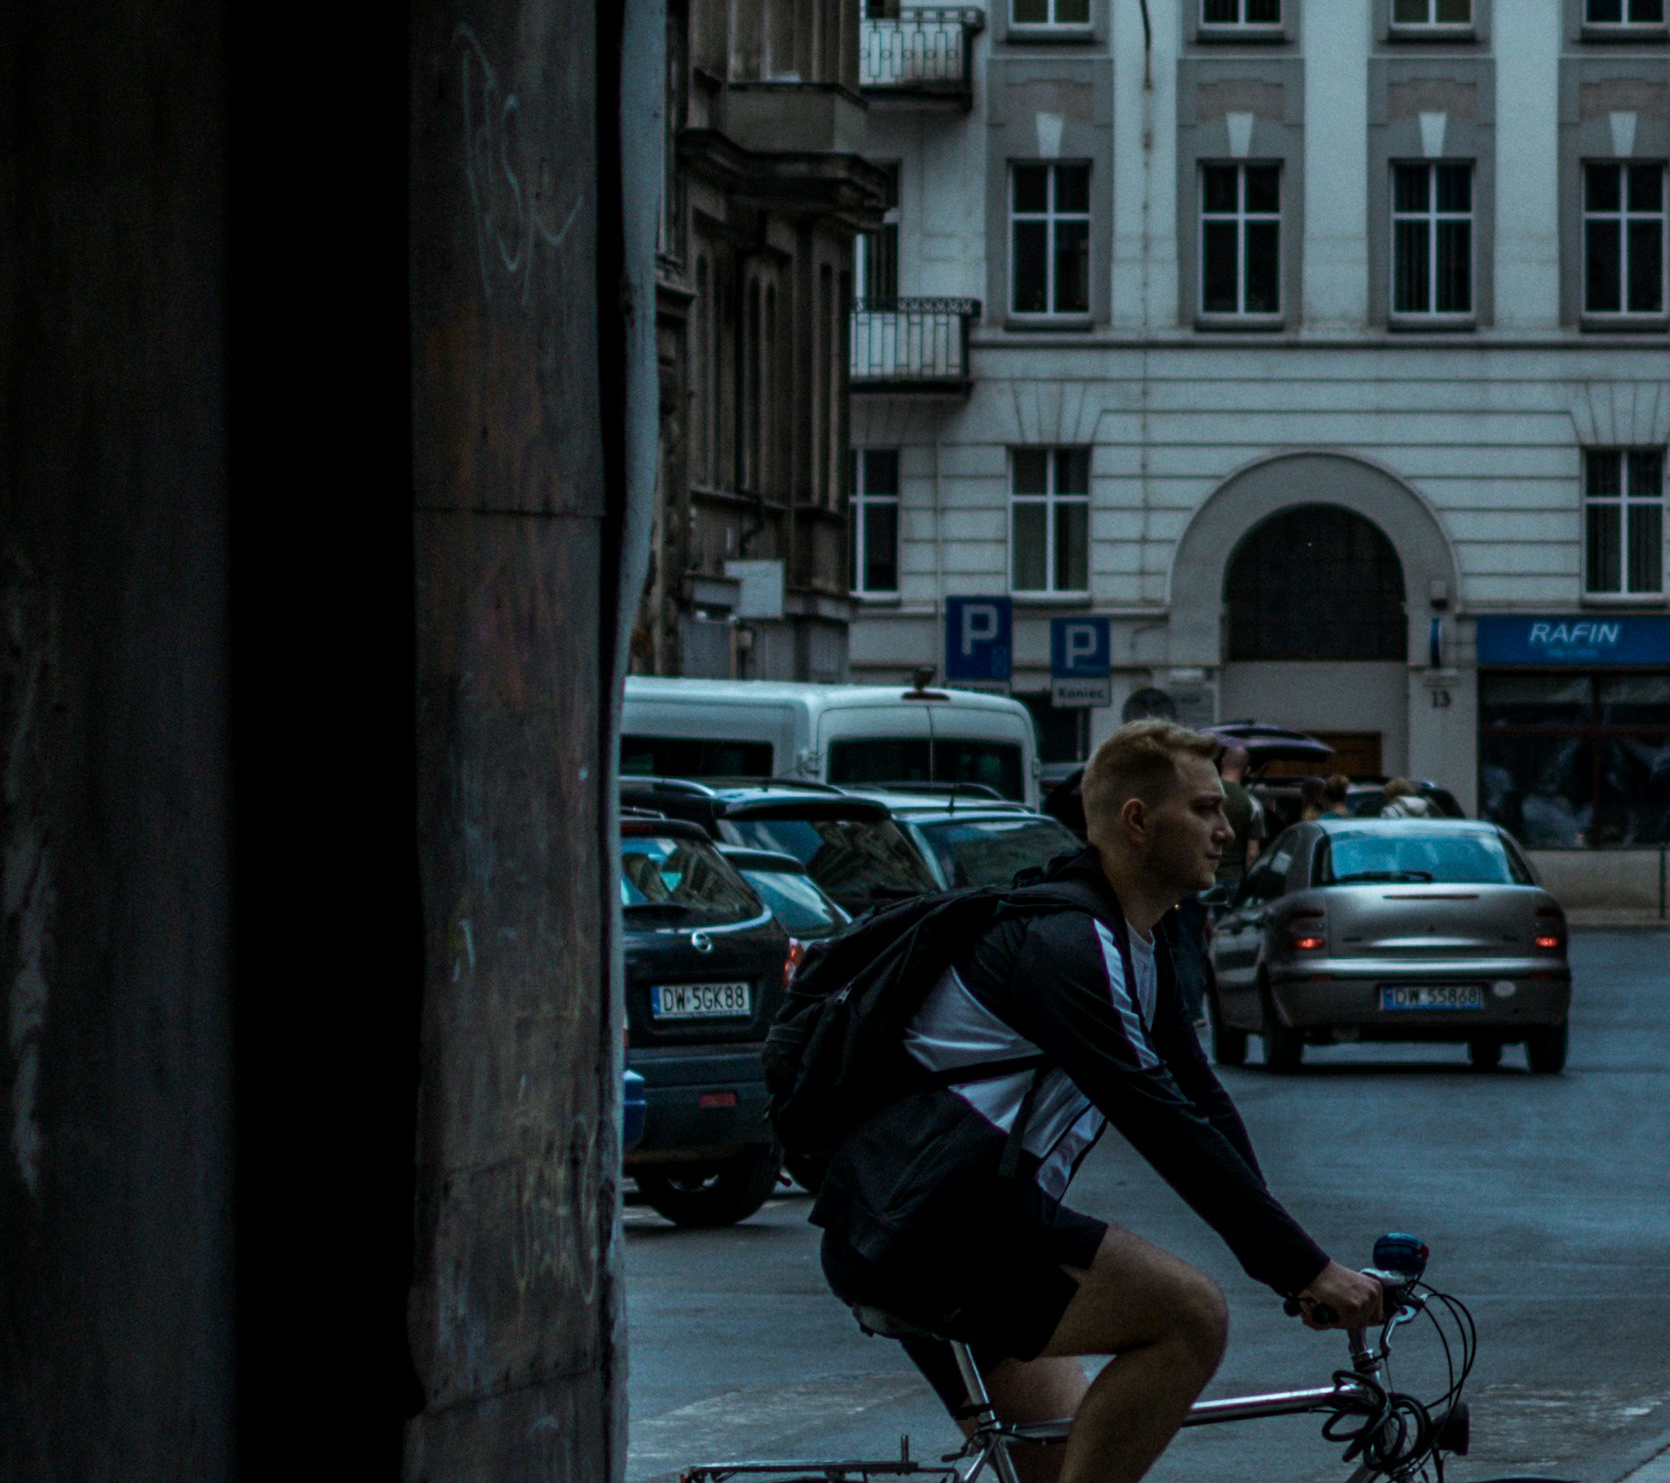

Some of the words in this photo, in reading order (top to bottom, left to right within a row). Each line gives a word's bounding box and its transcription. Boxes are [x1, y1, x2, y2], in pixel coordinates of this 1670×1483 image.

[962, 603, 999, 657] P
[1529, 622, 1621, 644] RAFIN
[1064, 624, 1098, 669] P
[1058, 686, 1104, 699] Koniec
[1431, 690, 1450, 708] 13
[663, 988, 686, 1011] DW
[692, 985, 745, 1010] 5GK88
[1395, 988, 1420, 1004] DW
[1428, 988, 1478, 1004] 55868
